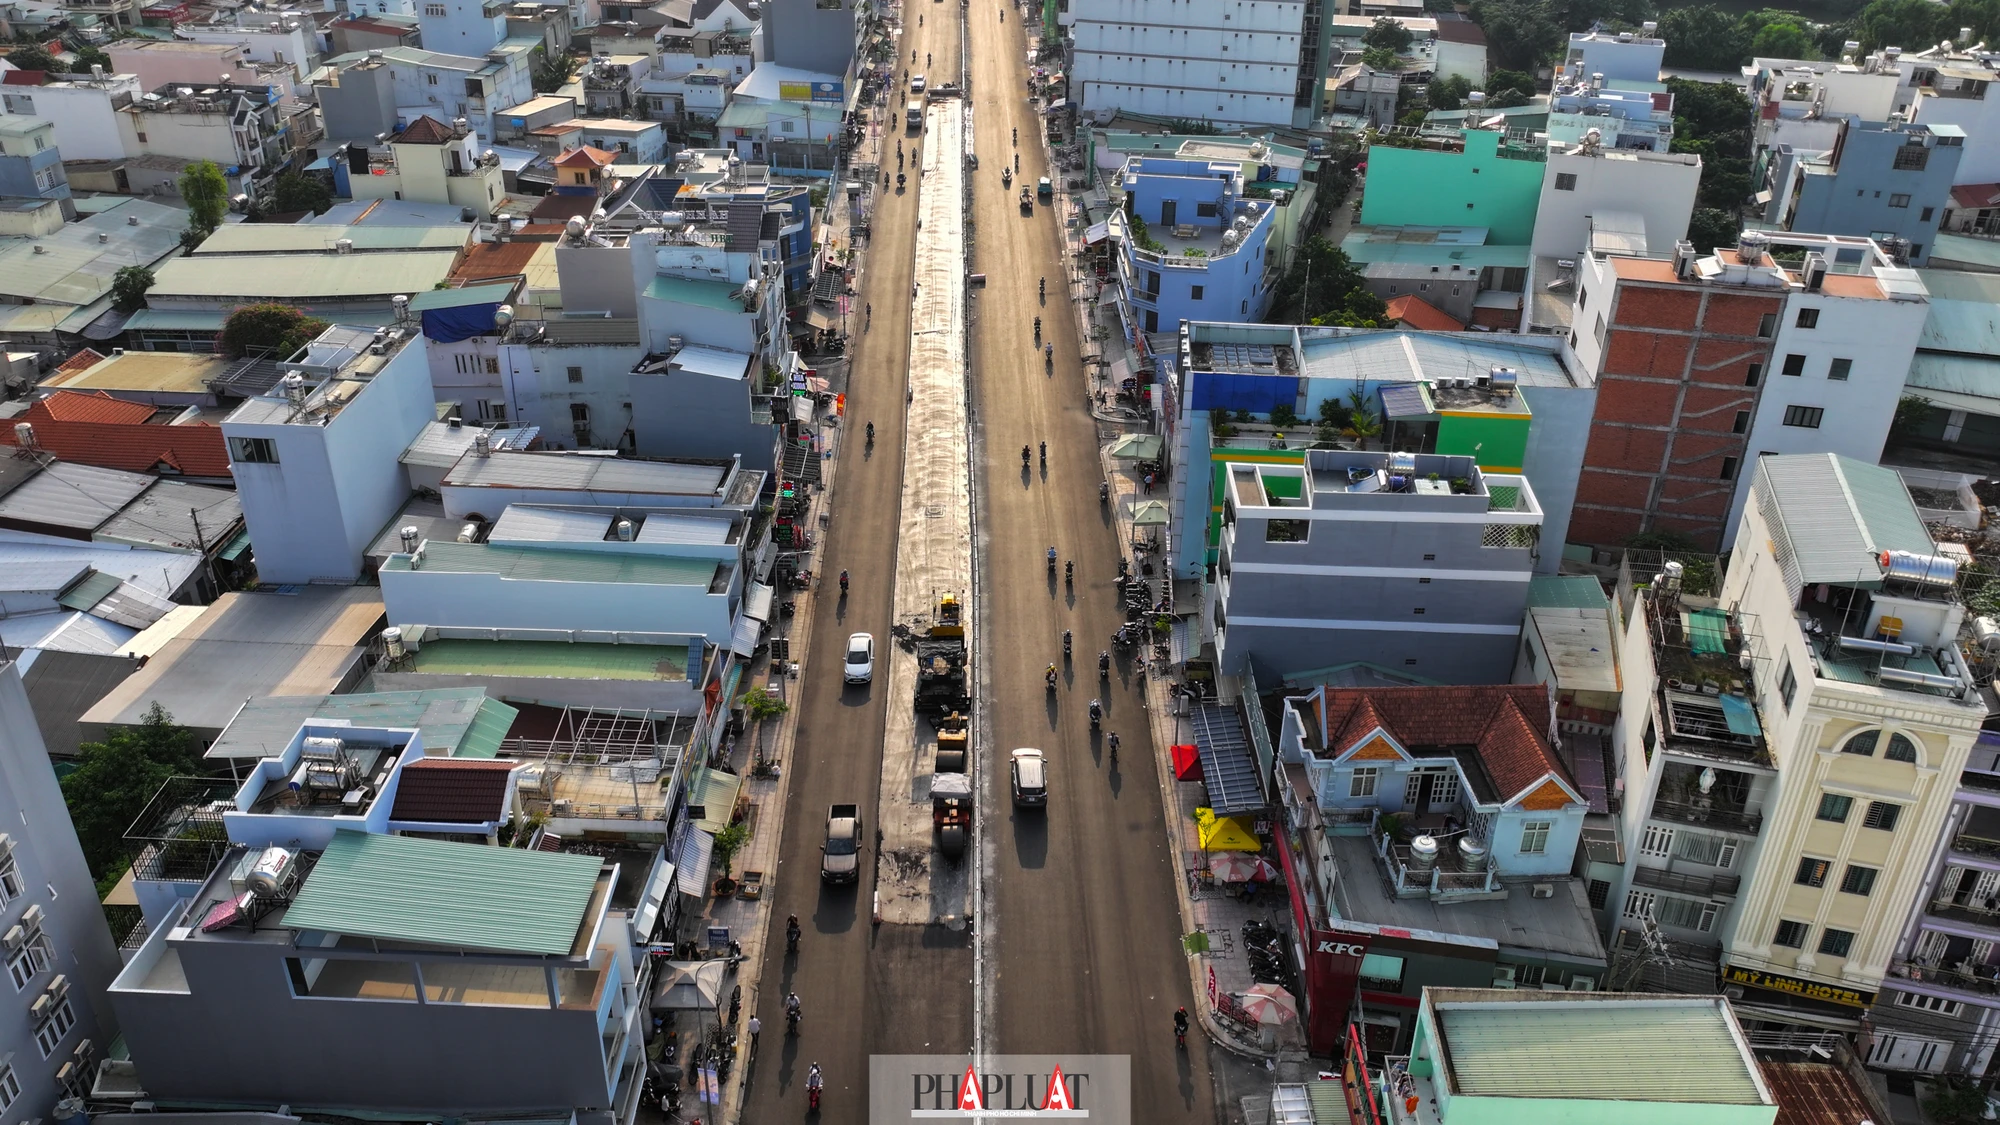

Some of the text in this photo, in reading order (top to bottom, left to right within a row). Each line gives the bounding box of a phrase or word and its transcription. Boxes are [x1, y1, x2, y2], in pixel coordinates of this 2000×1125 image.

[1317, 941, 1364, 957] KFC
[1733, 970, 1760, 984] MỸ
[1806, 985, 1863, 1006] HOTEL
